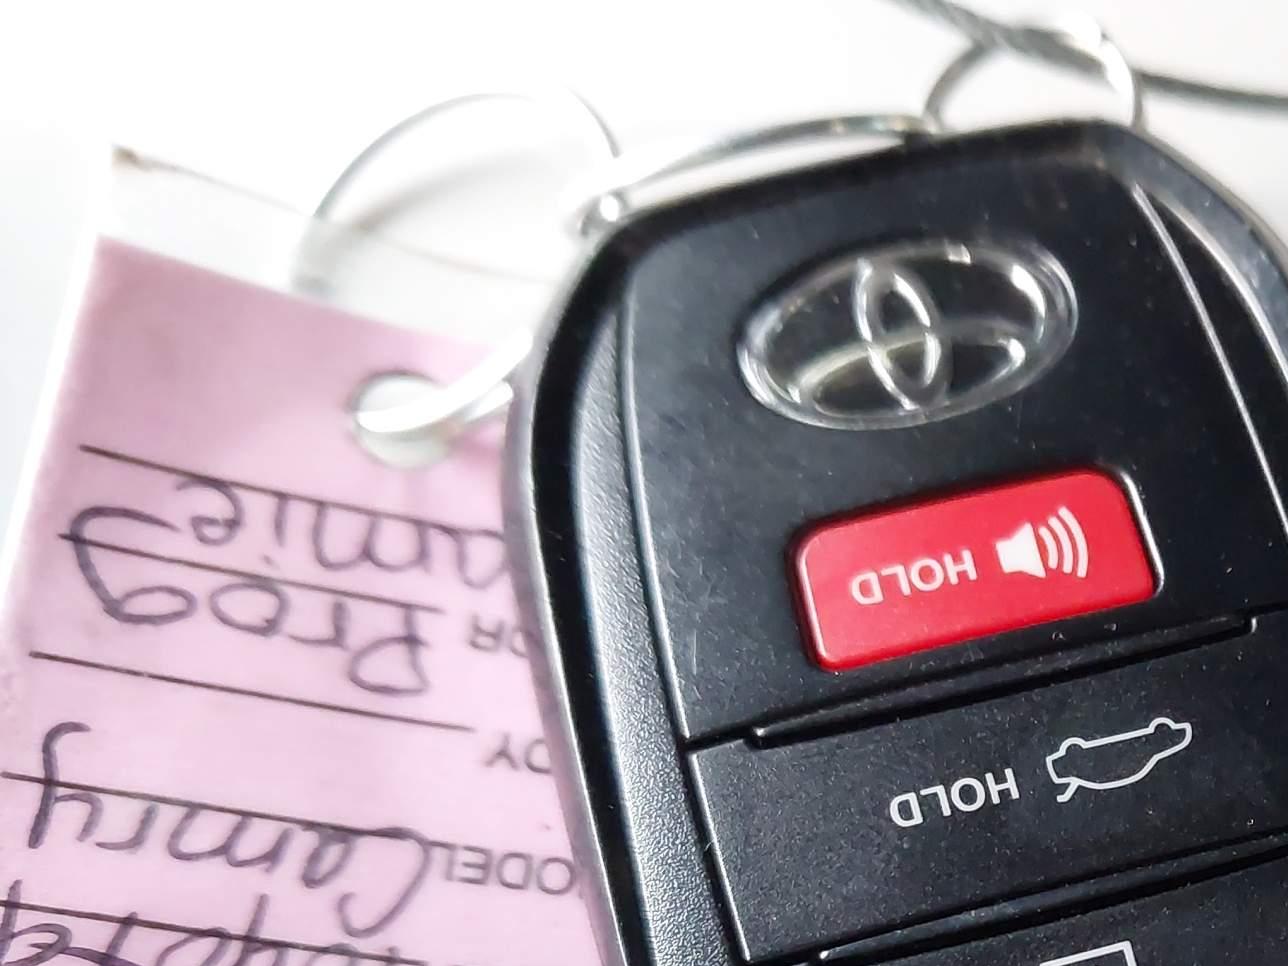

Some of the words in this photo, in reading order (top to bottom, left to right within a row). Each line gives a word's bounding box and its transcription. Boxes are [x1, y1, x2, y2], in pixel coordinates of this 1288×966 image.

[850, 548, 976, 605] HOLD
[889, 767, 1020, 828] HOLD
[29, 721, 430, 938] Camry
[432, 840, 577, 895] ODEL
